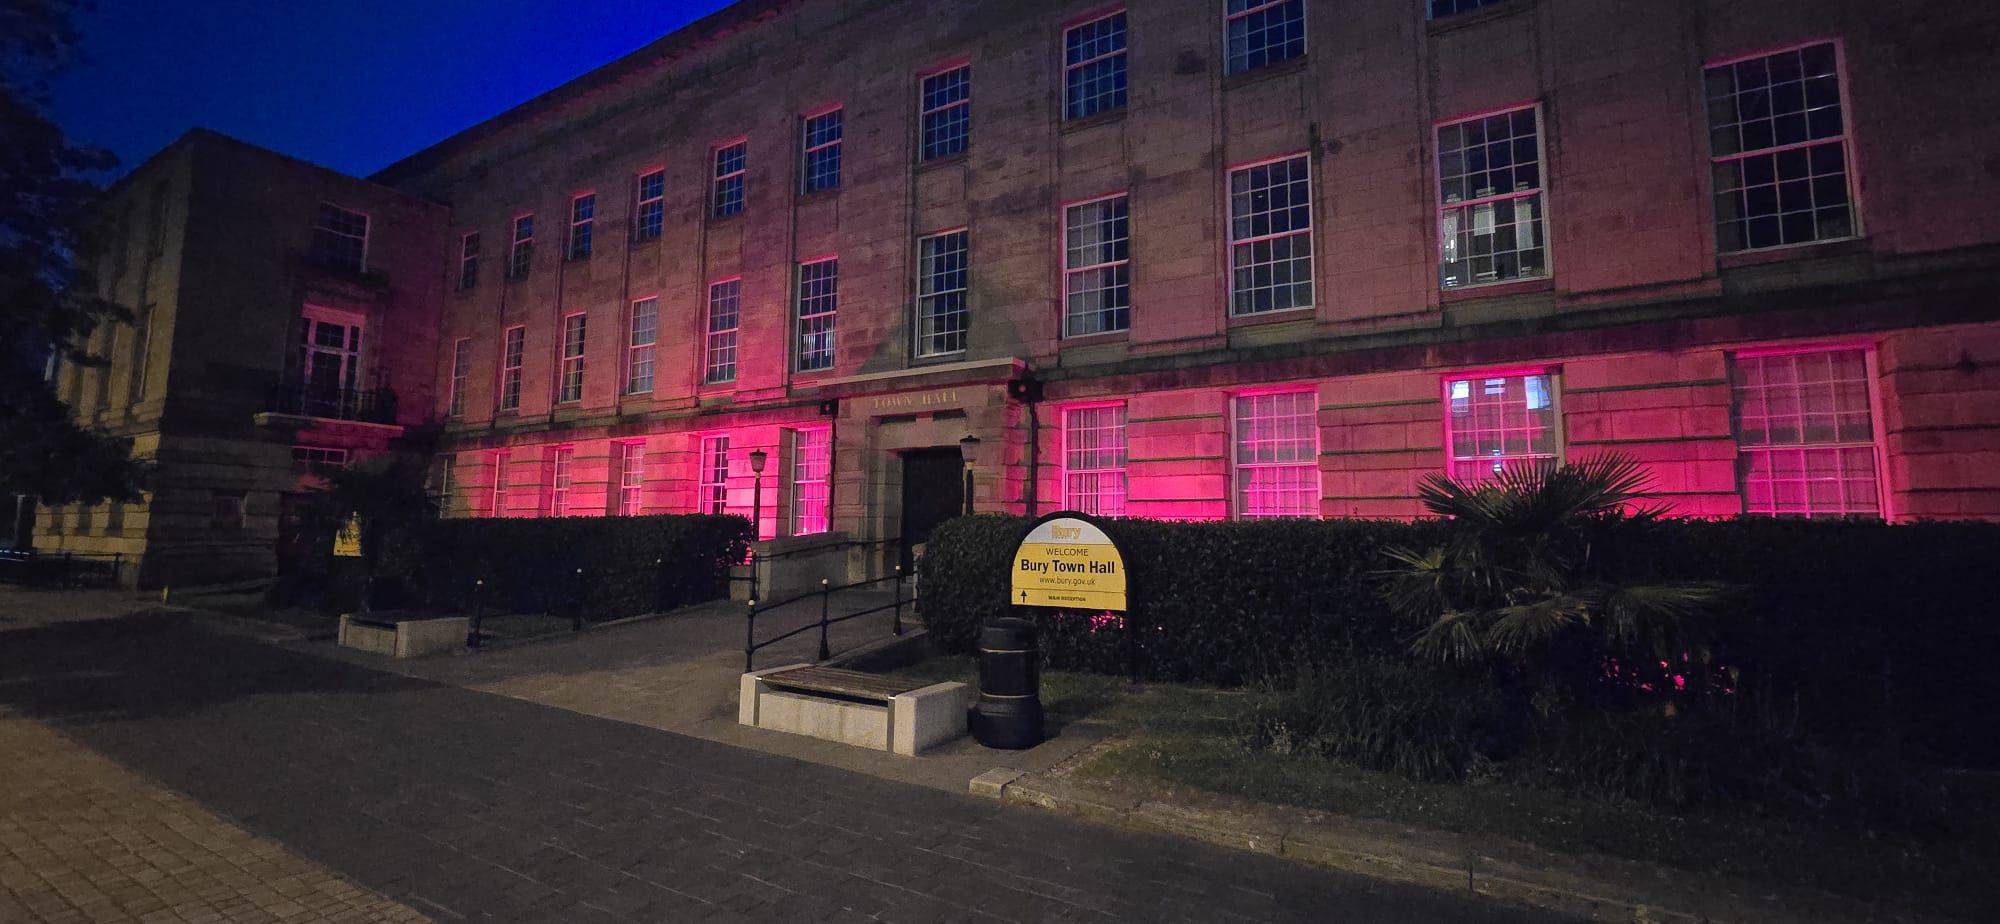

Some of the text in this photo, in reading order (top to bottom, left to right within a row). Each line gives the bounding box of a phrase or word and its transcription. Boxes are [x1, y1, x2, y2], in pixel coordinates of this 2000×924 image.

[873, 391, 958, 409] TOWN HALL
[1051, 525, 1081, 539] Bury
[1046, 548, 1089, 556] WELCOME
[1021, 559, 1115, 574] Bury Town Hall
[1039, 577, 1096, 586] www.bury.gov.uk
